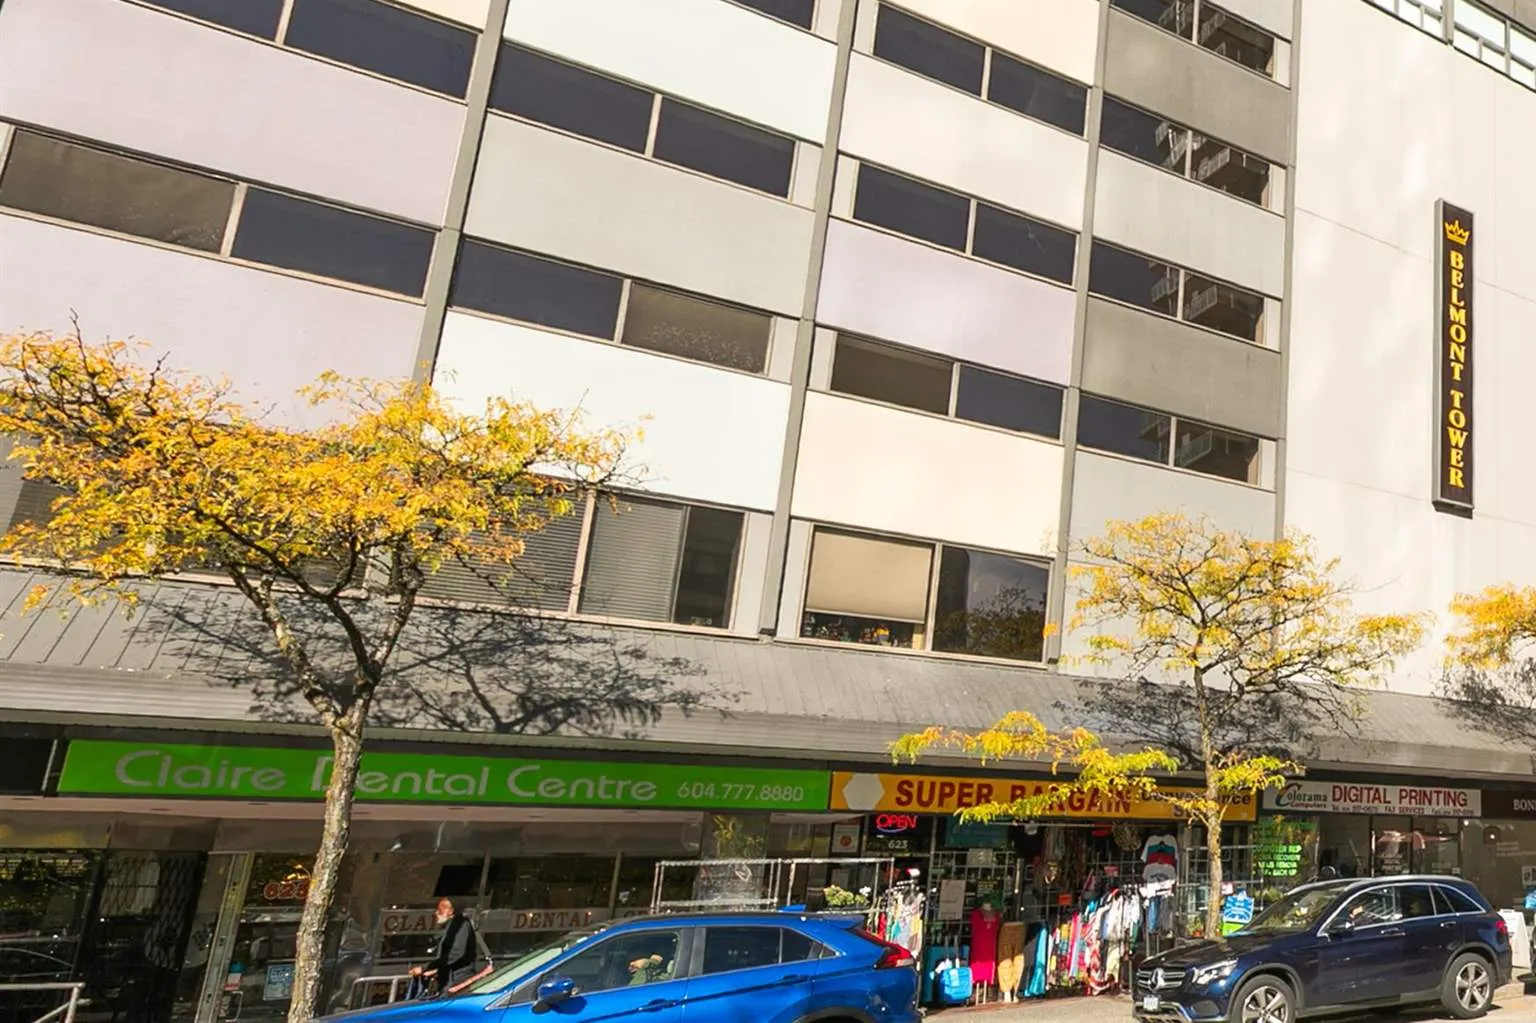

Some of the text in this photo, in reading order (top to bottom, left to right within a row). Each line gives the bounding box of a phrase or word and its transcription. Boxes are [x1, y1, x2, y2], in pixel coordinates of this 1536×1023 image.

[1448, 249, 1468, 488] BELMONT TOWER
[115, 749, 287, 791] Claire
[507, 764, 657, 801] Centre
[677, 781, 804, 802] 604.777.8880
[896, 779, 993, 808] SUPER
[1275, 782, 1328, 807] Colorama
[1290, 800, 1327, 810] Computers
[1332, 784, 1468, 808] DIGITAL PRINTING
[876, 814, 918, 829] OPEN
[888, 839, 909, 850] 623
[514, 912, 592, 929] DENTAL
